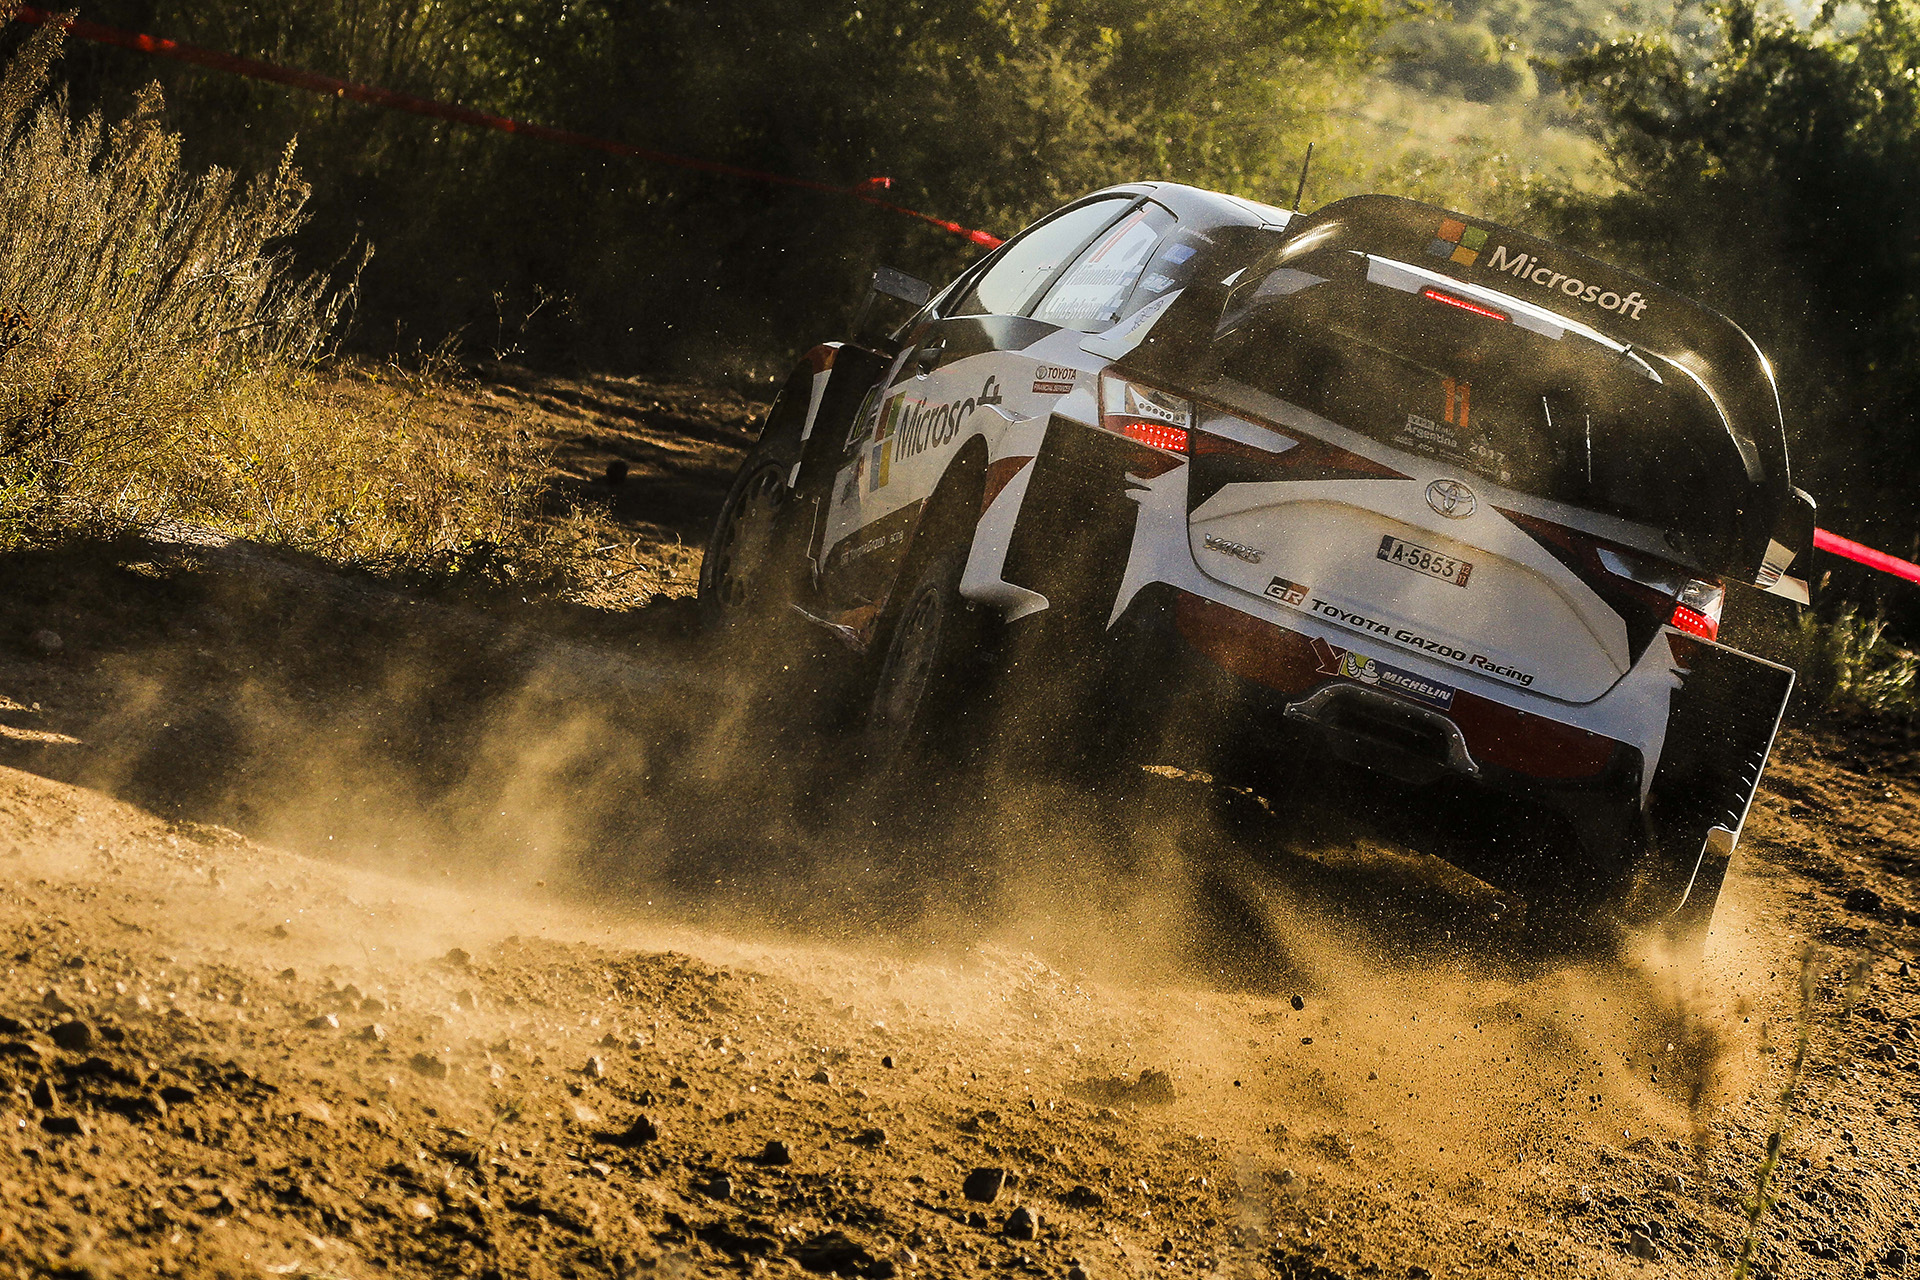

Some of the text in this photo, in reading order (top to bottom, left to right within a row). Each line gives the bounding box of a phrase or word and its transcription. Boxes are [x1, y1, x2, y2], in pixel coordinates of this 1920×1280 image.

[1487, 245, 1648, 321] Microsoft
[1047, 367, 1077, 380] TOYOTA
[1442, 377, 1471, 427] 11
[1404, 422, 1458, 448] Argentina
[1265, 583, 1305, 605] GR
[1311, 598, 1534, 687] TOYOTA GAZOO Racing
[1382, 671, 1452, 701] MICHELIN
